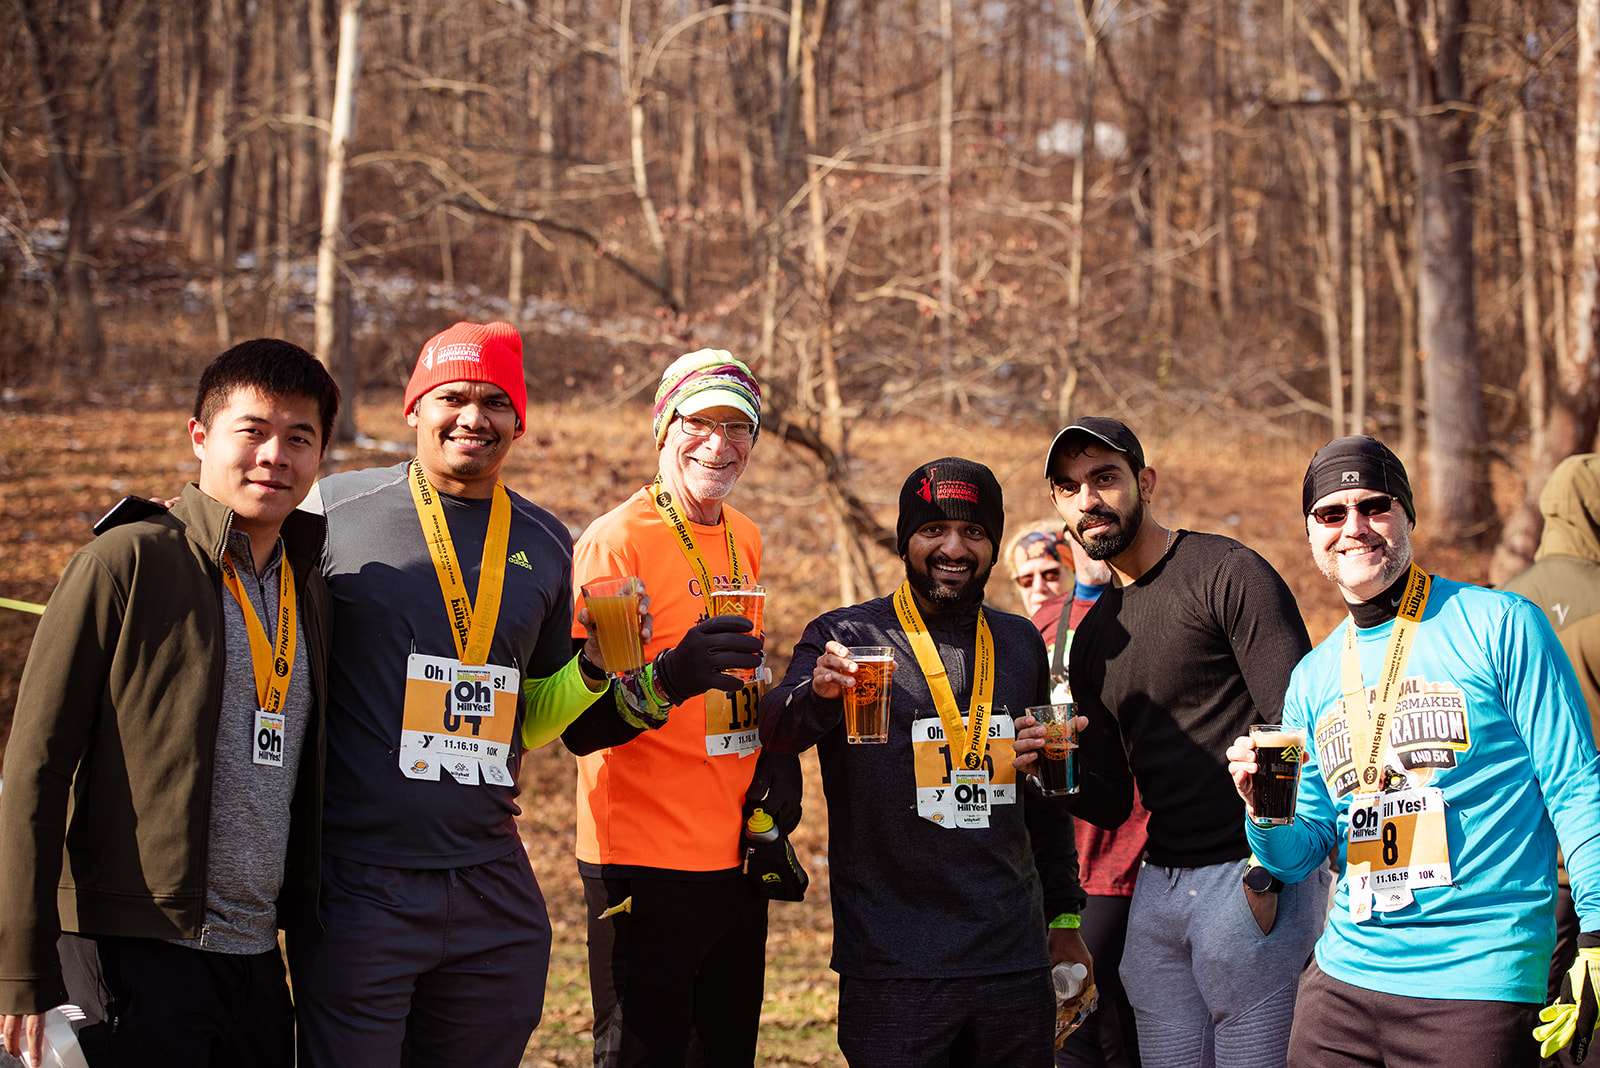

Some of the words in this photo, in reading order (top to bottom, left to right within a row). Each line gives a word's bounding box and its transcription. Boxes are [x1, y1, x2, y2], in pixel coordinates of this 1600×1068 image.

[413, 461, 433, 506] FINISHER
[666, 507, 694, 550] FINISHER
[508, 557, 532, 570] adidas
[280, 607, 290, 657] FINISHER
[277, 660, 286, 676] 10K
[424, 664, 443, 680] Oh
[493, 675, 506, 689] s!
[454, 681, 490, 702] Oh
[927, 727, 944, 740] Oh
[989, 724, 1000, 738] s!
[971, 705, 985, 751] FINISHER
[1370, 712, 1387, 764] FINISHER
[1390, 711, 1466, 748] RATHON
[258, 728, 281, 750] Oh
[444, 740, 479, 752] 11.16.19
[486, 747, 498, 756] 10K
[1411, 751, 1432, 764] AND
[1433, 751, 1450, 763] 5K
[955, 784, 986, 803] Oh
[994, 789, 1005, 798] 10K
[1383, 800, 1393, 817] ill
[1397, 797, 1427, 814] Yes!
[1352, 807, 1379, 829] Oh
[1383, 822, 1398, 866] 8
[1376, 872, 1408, 884] 11.16.19
[1419, 870, 1435, 879] 10K
